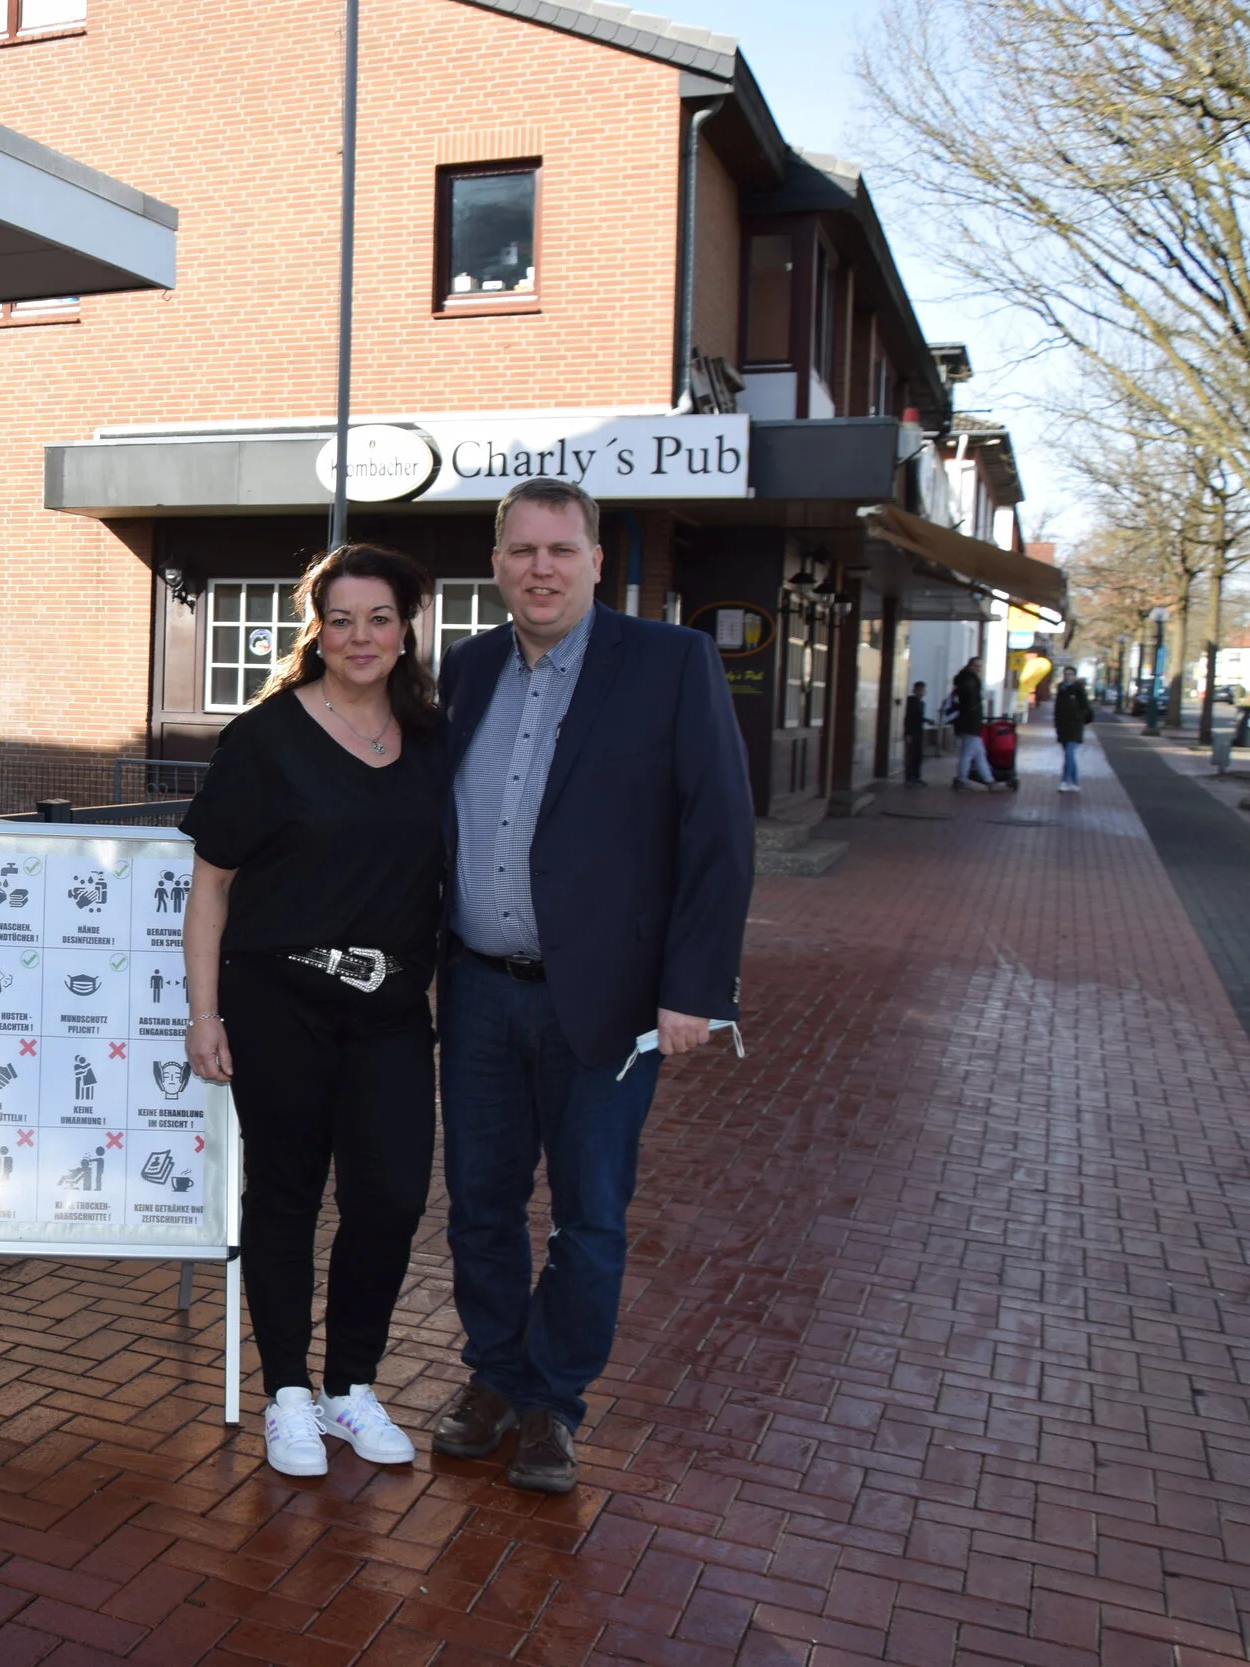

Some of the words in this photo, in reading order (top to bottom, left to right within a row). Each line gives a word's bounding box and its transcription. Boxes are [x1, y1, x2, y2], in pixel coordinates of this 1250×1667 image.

[651, 434, 741, 475] Pub
[330, 457, 419, 478] Kombacher
[77, 925, 100, 934] HÄNDE
[146, 928, 182, 937] BERATUNG
[62, 935, 111, 945] DESINFIZIEREN
[151, 938, 164, 947] DEN
[1, 1012, 28, 1021] HUSTEN
[60, 1014, 108, 1024] MUNDSCHUTZ
[139, 1017, 170, 1026] ABSTAND
[68, 1025, 95, 1034] PFLICHT
[73, 1105, 93, 1114] KEINE
[138, 1108, 157, 1117] KEINE
[158, 1109, 204, 1118] BEHANDLUNG
[60, 1116, 102, 1125] UMARMUNG
[148, 1119, 157, 1128] IM
[158, 1119, 188, 1128] GESICHT
[134, 1203, 154, 1212] KEINE
[155, 1203, 190, 1213] GETRÄNKE
[142, 1214, 193, 1224] ZEITSCHRIFTEN
